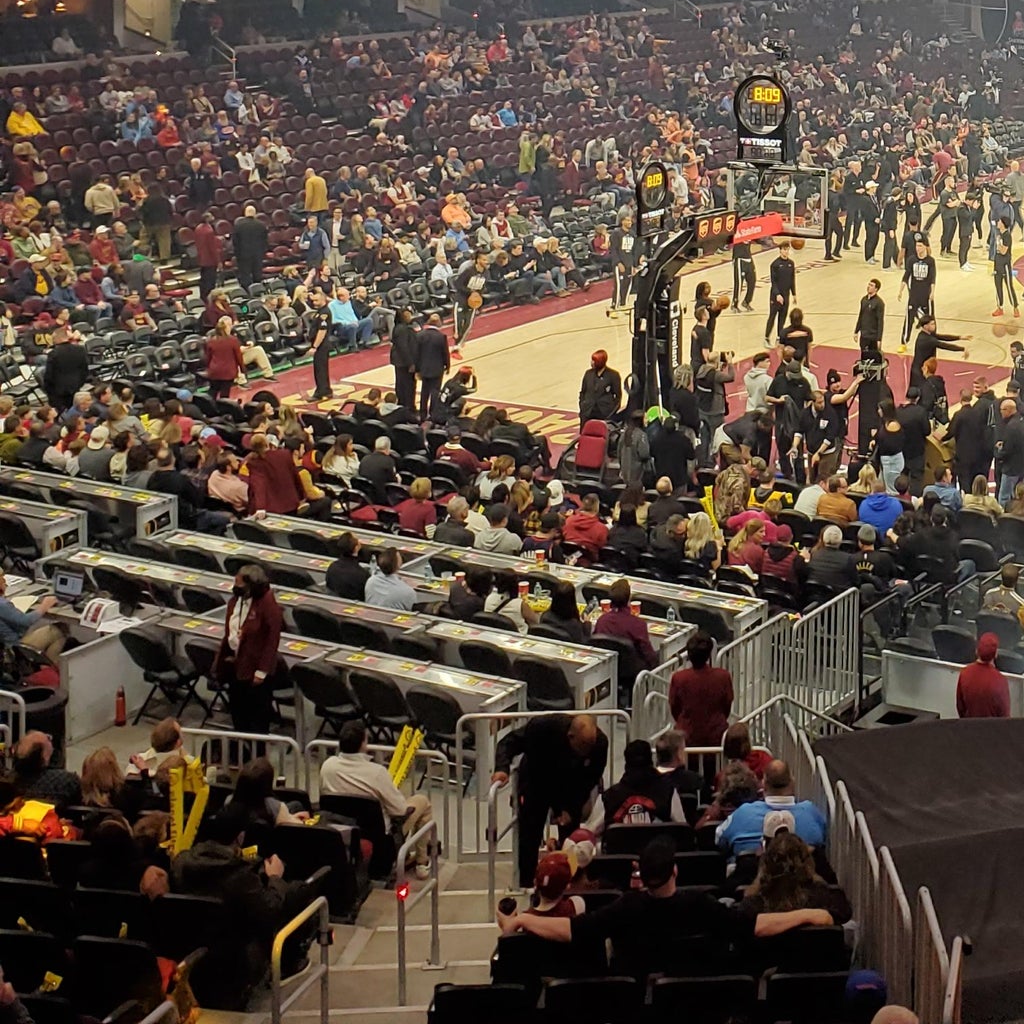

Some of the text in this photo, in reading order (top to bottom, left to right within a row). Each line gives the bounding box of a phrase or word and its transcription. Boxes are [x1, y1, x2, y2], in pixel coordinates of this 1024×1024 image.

[754, 87, 781, 103] 8:09
[751, 138, 782, 147] TISSOT
[647, 173, 662, 188] 8:09
[671, 319, 679, 368] Cleveland
